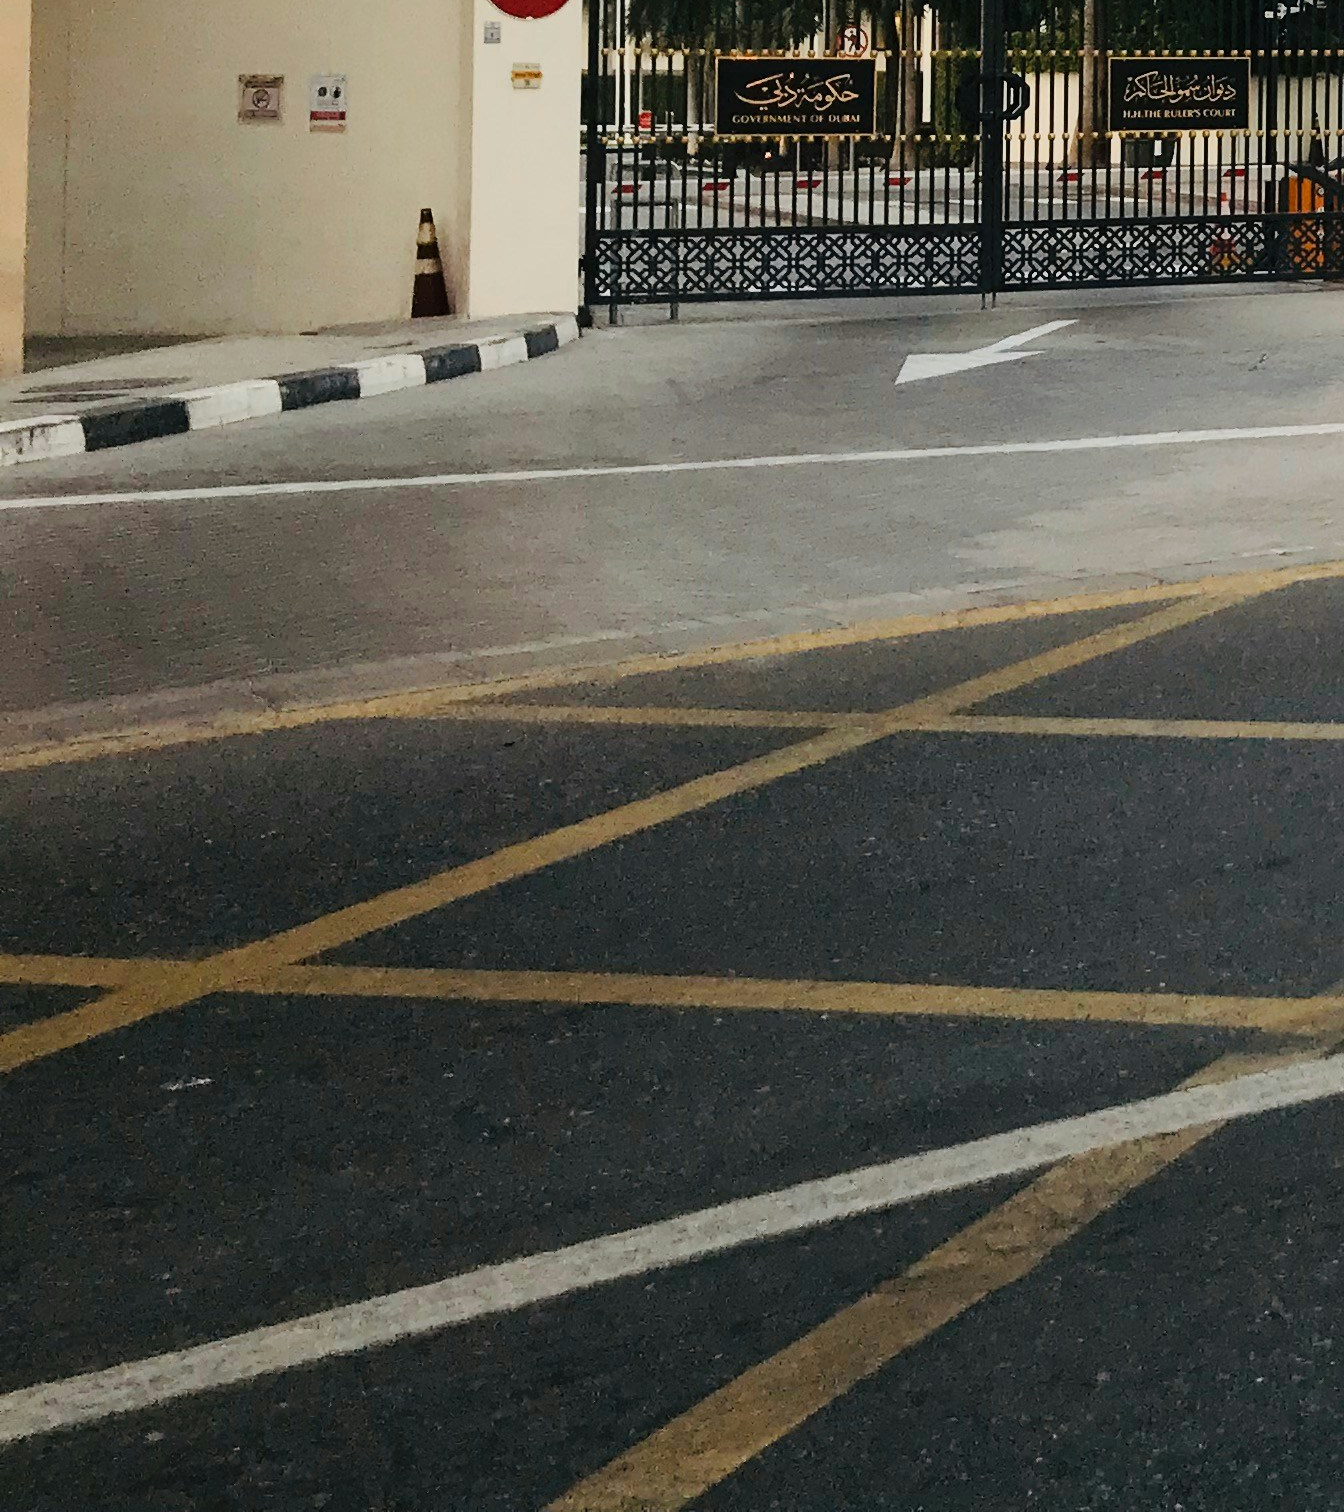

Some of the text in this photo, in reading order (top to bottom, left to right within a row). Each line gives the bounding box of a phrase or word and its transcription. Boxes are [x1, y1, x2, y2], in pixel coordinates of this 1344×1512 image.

[1164, 108, 1201, 118] RULER'S
[1202, 108, 1236, 118] COURT
[732, 114, 860, 124] GOVERNMENT OF DUBAI
